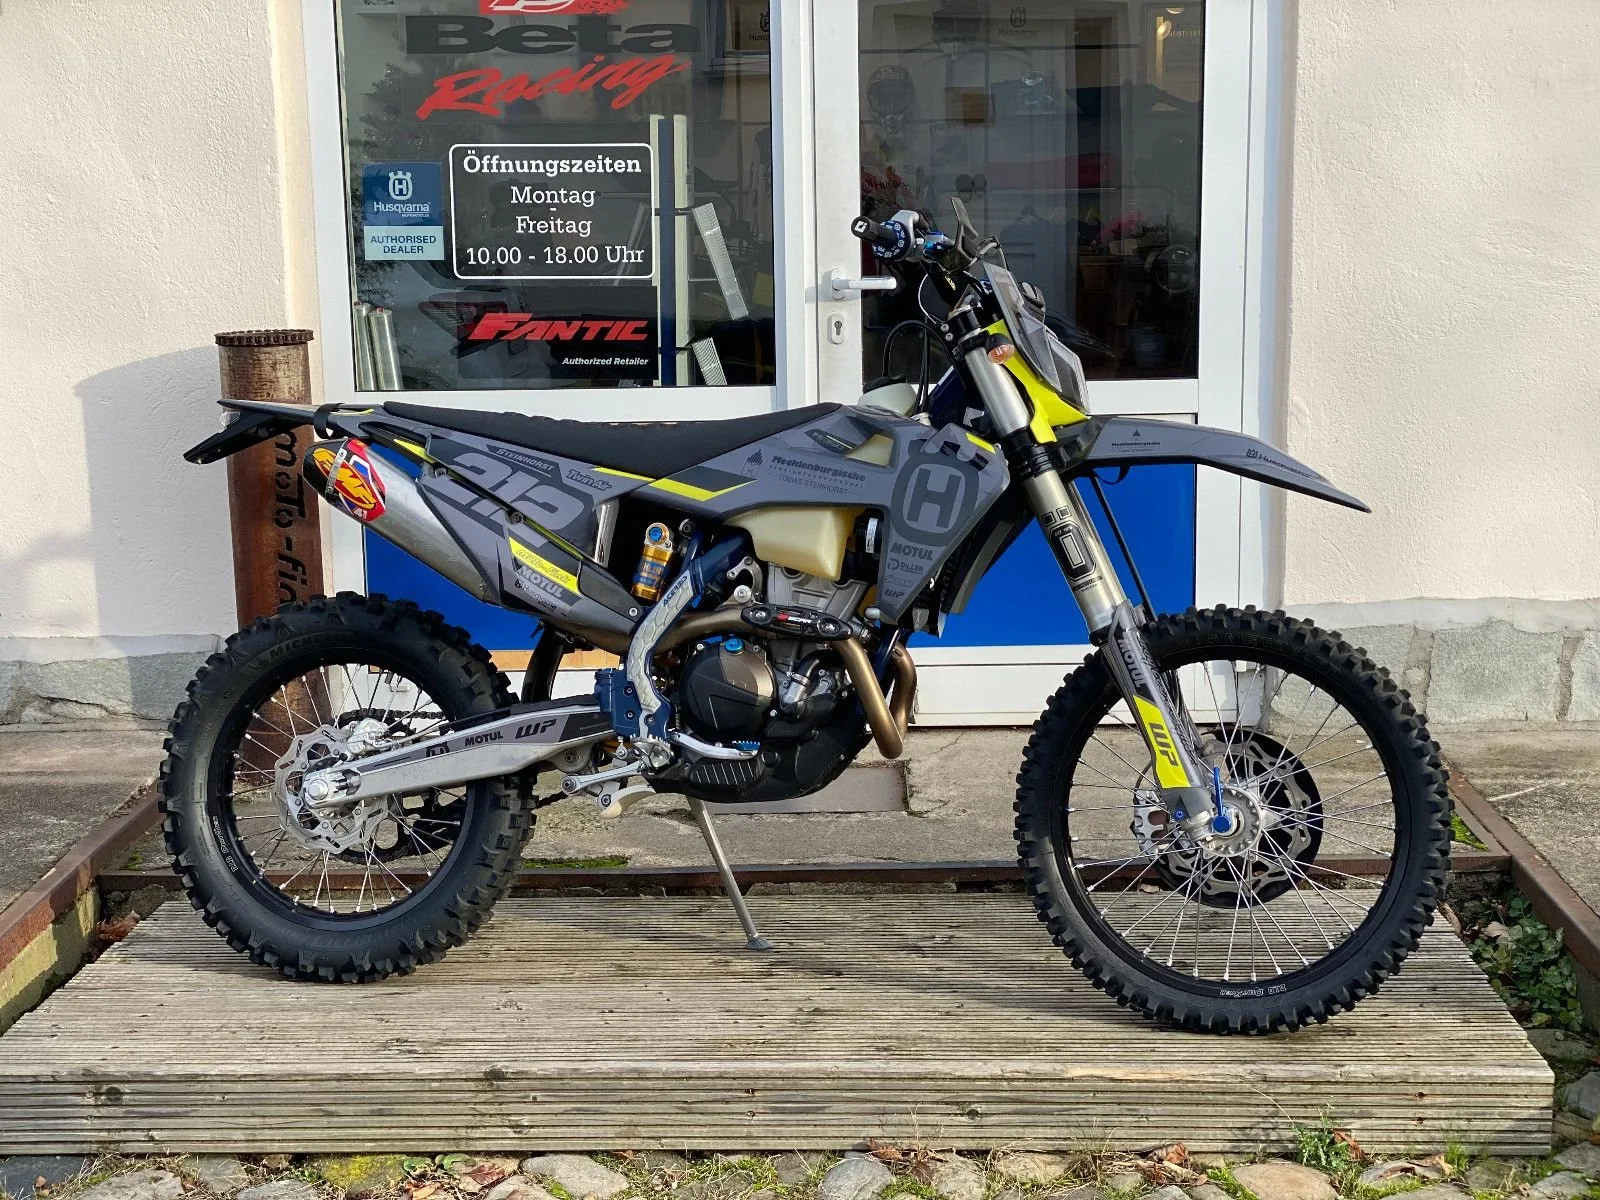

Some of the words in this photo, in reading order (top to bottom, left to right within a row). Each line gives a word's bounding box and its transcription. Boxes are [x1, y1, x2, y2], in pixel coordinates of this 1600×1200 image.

[405, 15, 700, 54] Beta
[416, 54, 693, 120] Racing
[463, 150, 642, 177] Öffnungszeiten
[373, 201, 431, 213] Husqvarna
[510, 186, 596, 207] Montag
[515, 216, 592, 237] Freitag
[370, 235, 437, 244] AUTHORISED
[383, 245, 424, 254] DEALER
[466, 246, 522, 264] 10.00
[543, 246, 599, 264] 18.00
[604, 246, 645, 263] Uhr
[467, 312, 649, 341] FANTIC
[561, 357, 612, 366] Authorized
[613, 358, 649, 366] Retailer
[495, 448, 555, 471] STEINHORST
[771, 455, 866, 482] Mecklenburgische
[779, 474, 803, 485] TOBIAS
[803, 480, 849, 494] STEINHORST
[889, 543, 934, 561] MOTUL
[899, 562, 924, 571] DILLER
[517, 564, 564, 598] MOTUL
[1117, 639, 1147, 688] MOTUL
[464, 730, 503, 747] MOTUL
[514, 719, 558, 739] WP
[1148, 722, 1178, 766] WP
